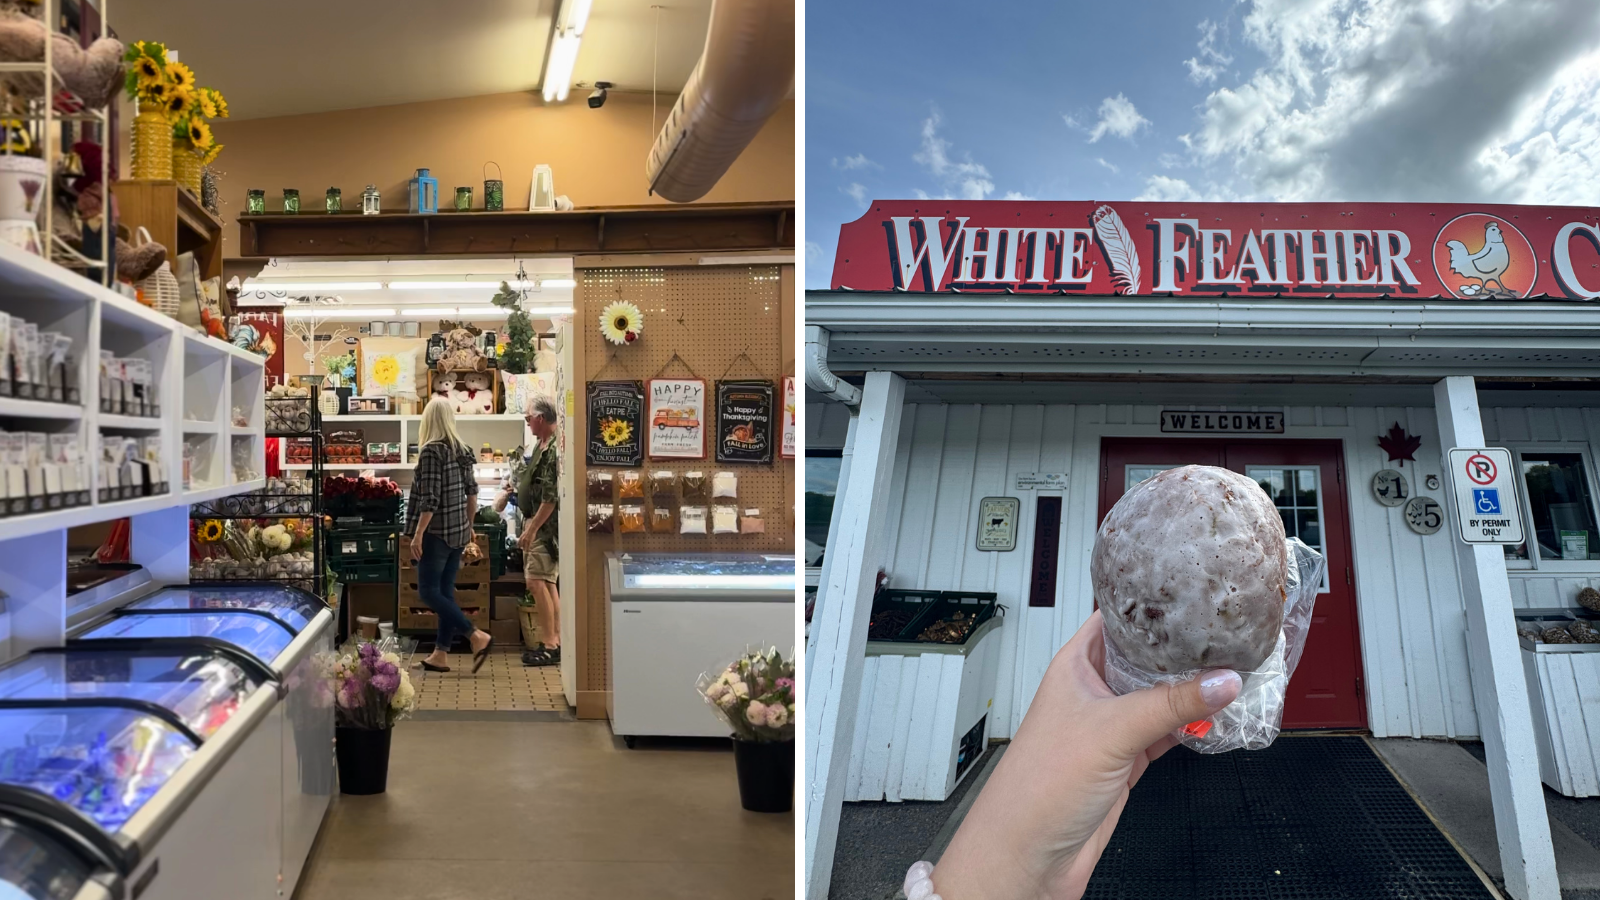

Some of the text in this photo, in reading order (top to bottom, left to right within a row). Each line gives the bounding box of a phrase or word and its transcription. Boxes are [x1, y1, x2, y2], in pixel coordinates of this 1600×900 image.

[891, 216, 1093, 292] WHITE
[1152, 218, 1421, 291] FEATHER
[654, 384, 701, 395] HAPPY
[606, 407, 616, 415] EAT
[733, 406, 756, 414] Happy
[722, 413, 768, 423] Thanksgiving
[1170, 415, 1275, 430] WELCOME
[1390, 477, 1407, 499] 1
[1424, 503, 1441, 528] 5
[1469, 519, 1511, 527] BY PERMIT
[1482, 528, 1501, 536] ONLY
